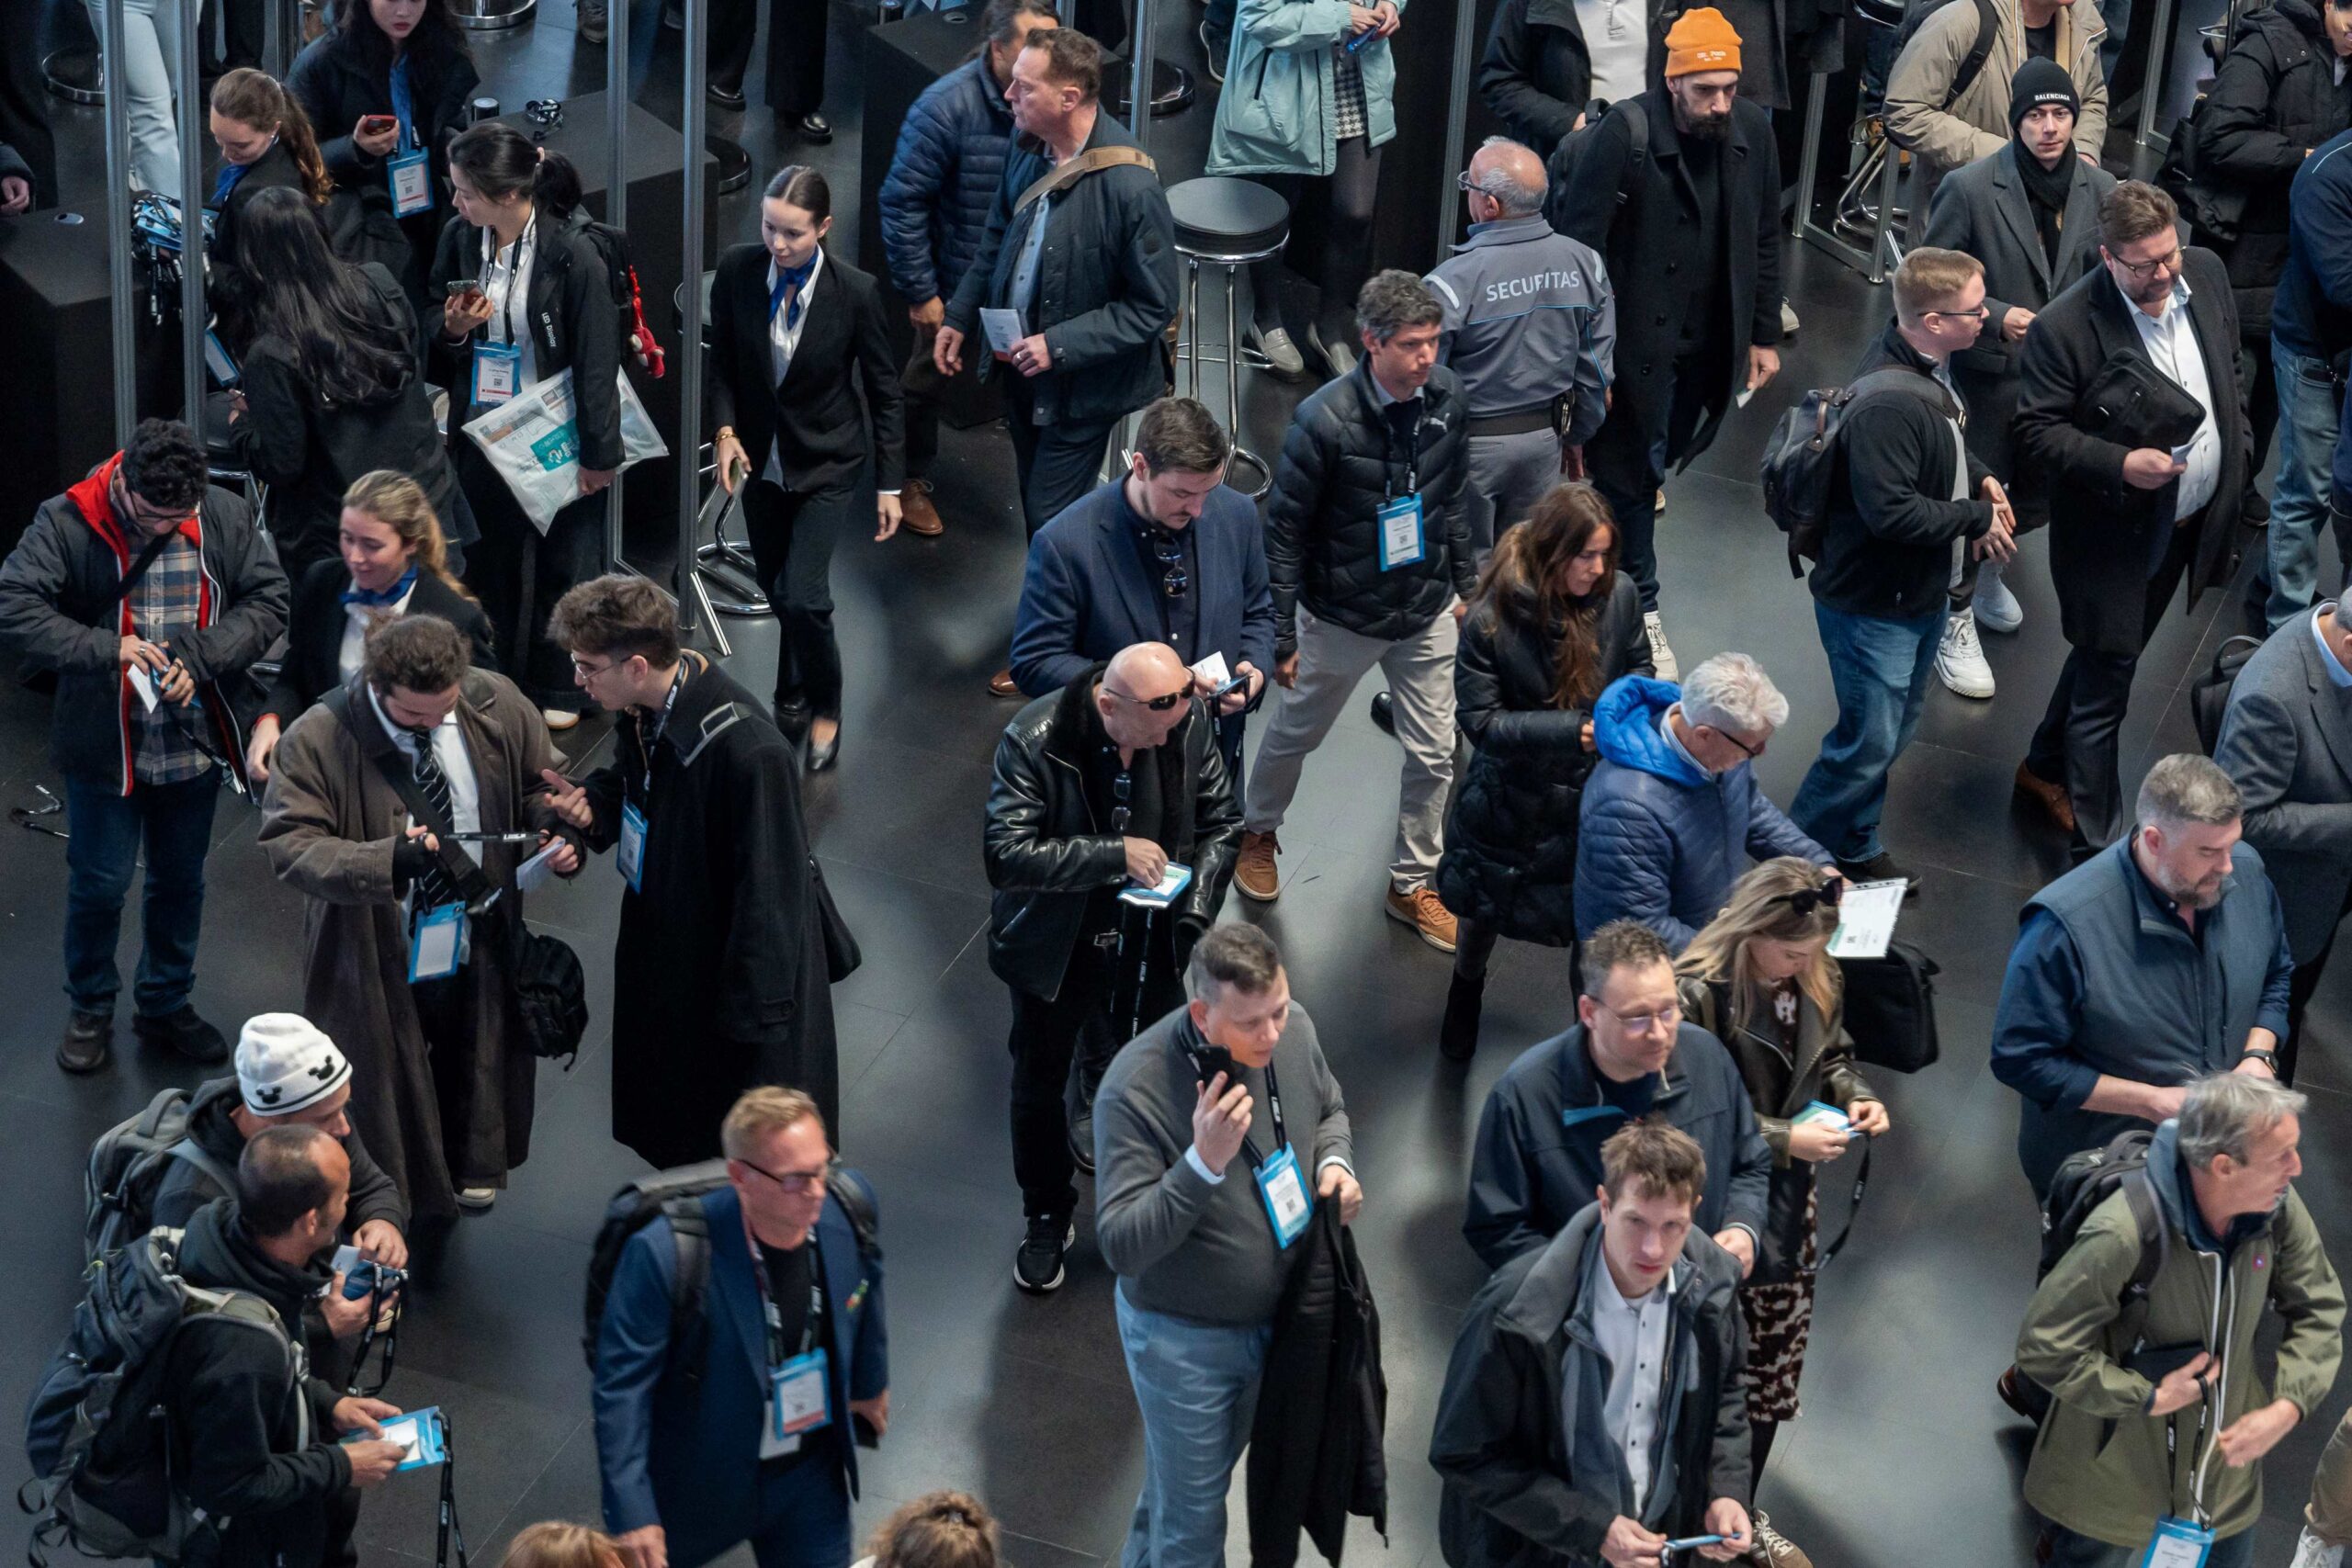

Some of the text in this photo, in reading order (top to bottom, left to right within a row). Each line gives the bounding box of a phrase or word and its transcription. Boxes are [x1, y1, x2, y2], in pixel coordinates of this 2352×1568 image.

[2034, 93, 2071, 101] BALENCIAGA
[1486, 270, 1580, 302] SECURITAS
[542, 312, 550, 323] LED
